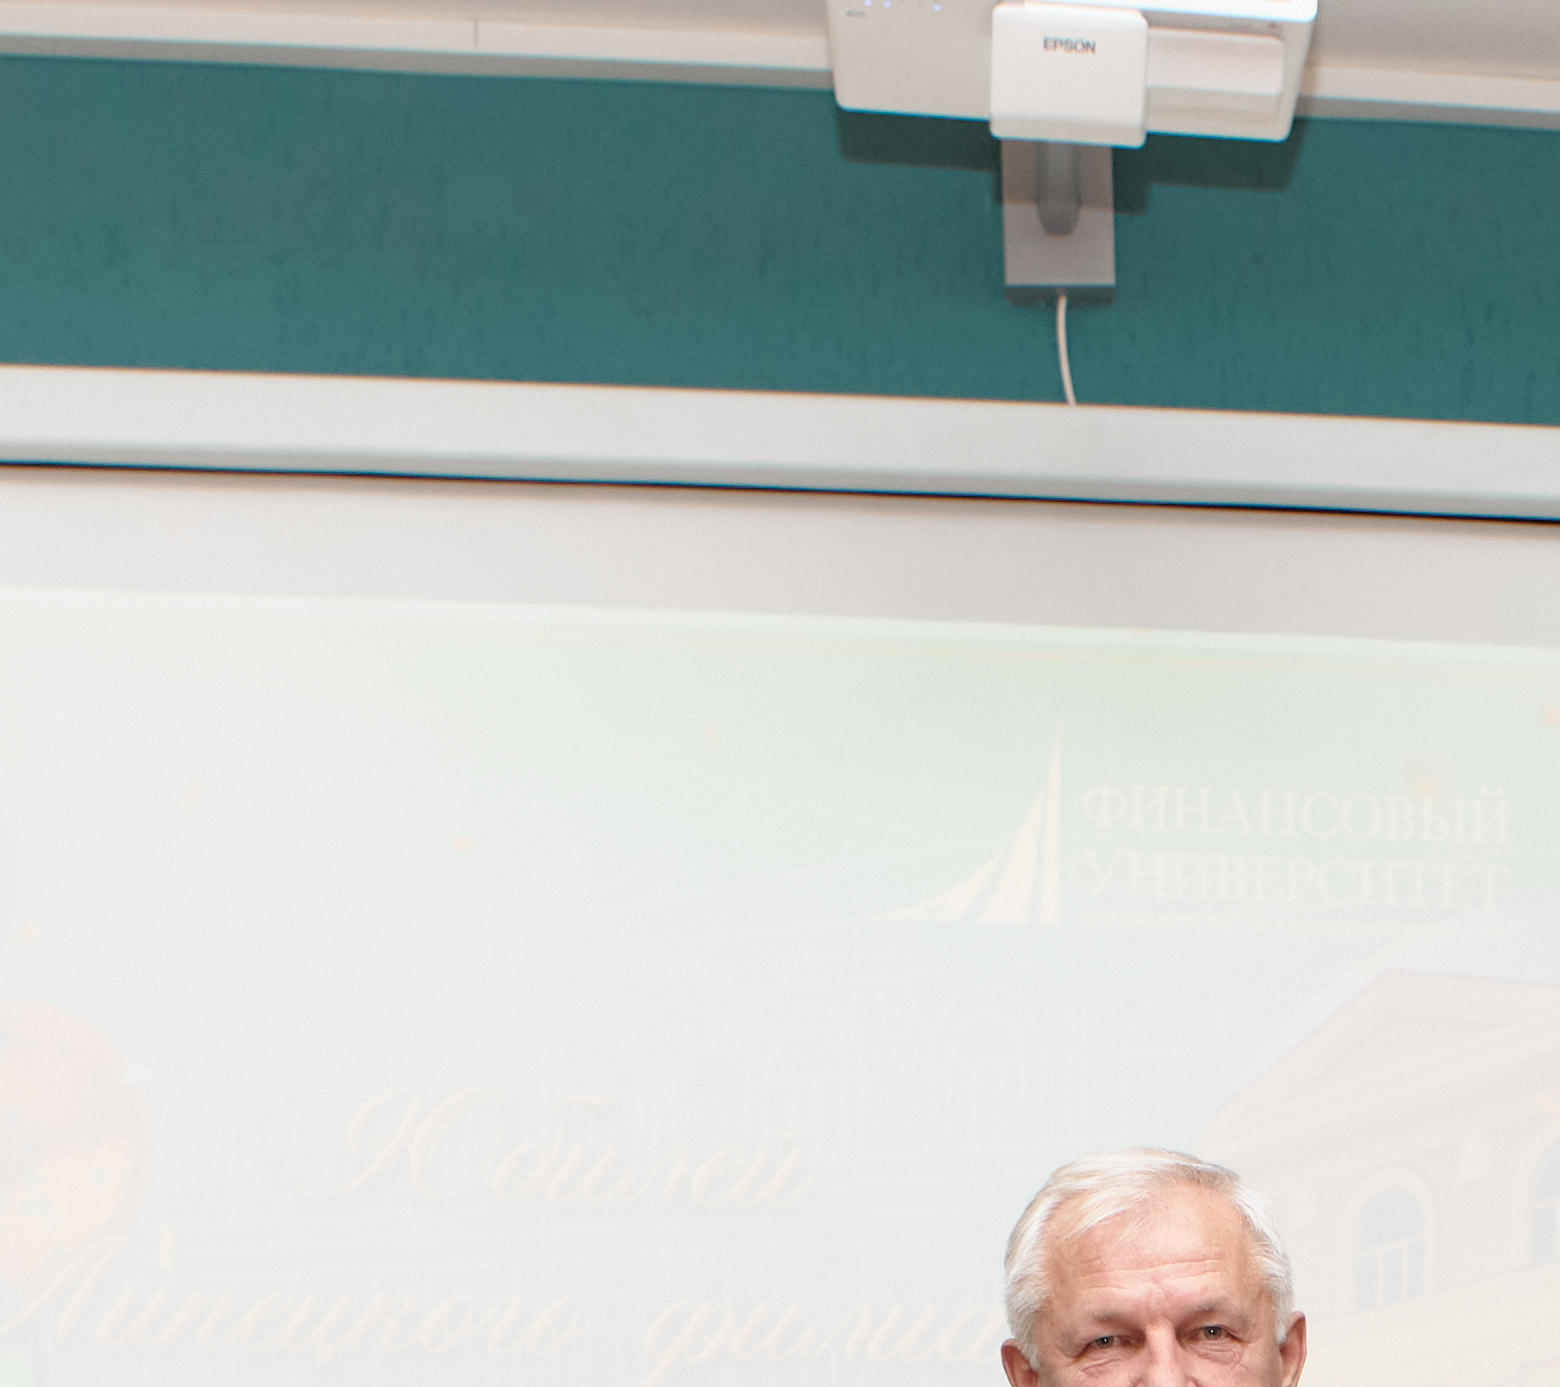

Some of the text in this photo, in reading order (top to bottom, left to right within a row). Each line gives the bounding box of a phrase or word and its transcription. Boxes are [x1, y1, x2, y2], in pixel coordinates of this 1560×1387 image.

[1043, 37, 1096, 54] EPSON
[1082, 783, 1513, 846] ФИНАНСОВЫЙ
[1083, 848, 1512, 912] УНИВЕРСИТЕТ
[302, 1085, 810, 1204] Юбилей
